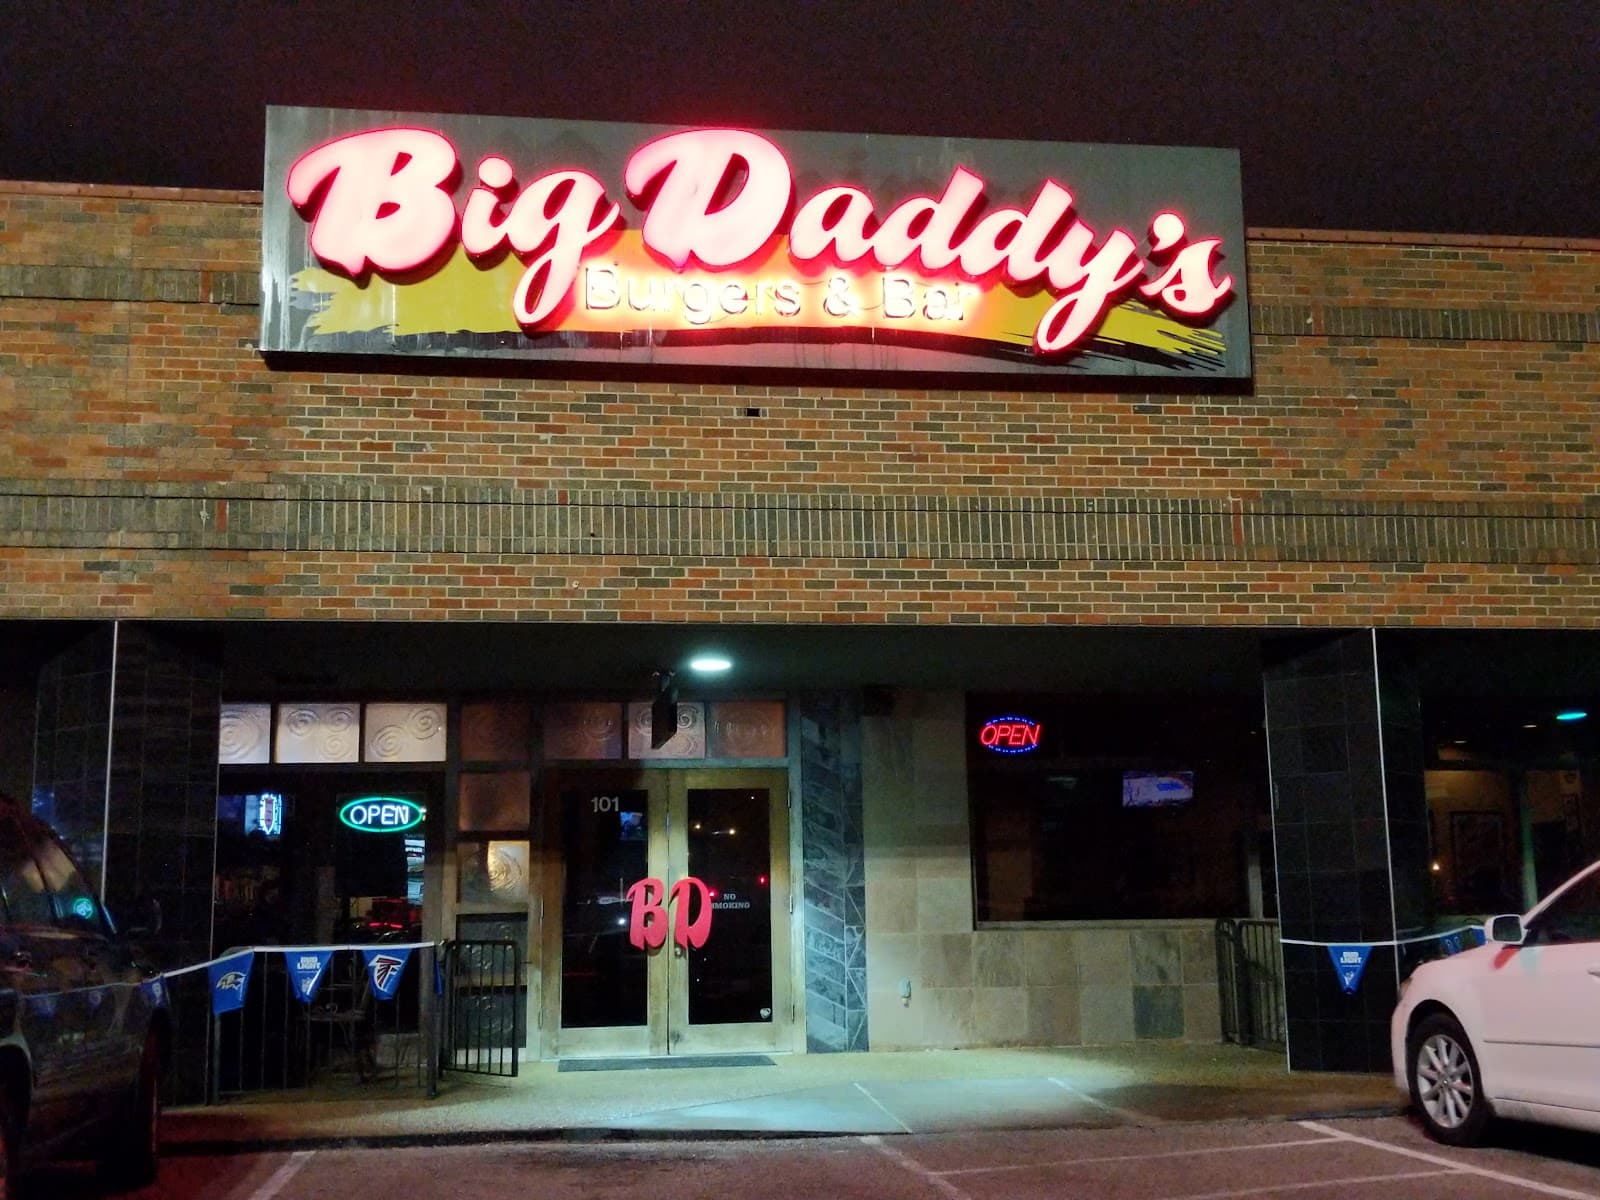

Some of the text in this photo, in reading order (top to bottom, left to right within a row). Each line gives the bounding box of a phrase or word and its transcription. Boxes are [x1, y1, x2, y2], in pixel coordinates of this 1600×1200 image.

[287, 127, 1234, 356] Big Daddy's
[584, 266, 976, 326] Burgers & Bar
[981, 725, 1040, 745] OPEN
[349, 804, 409, 825] OPEN
[590, 796, 619, 813] 101
[723, 893, 737, 901] NO
